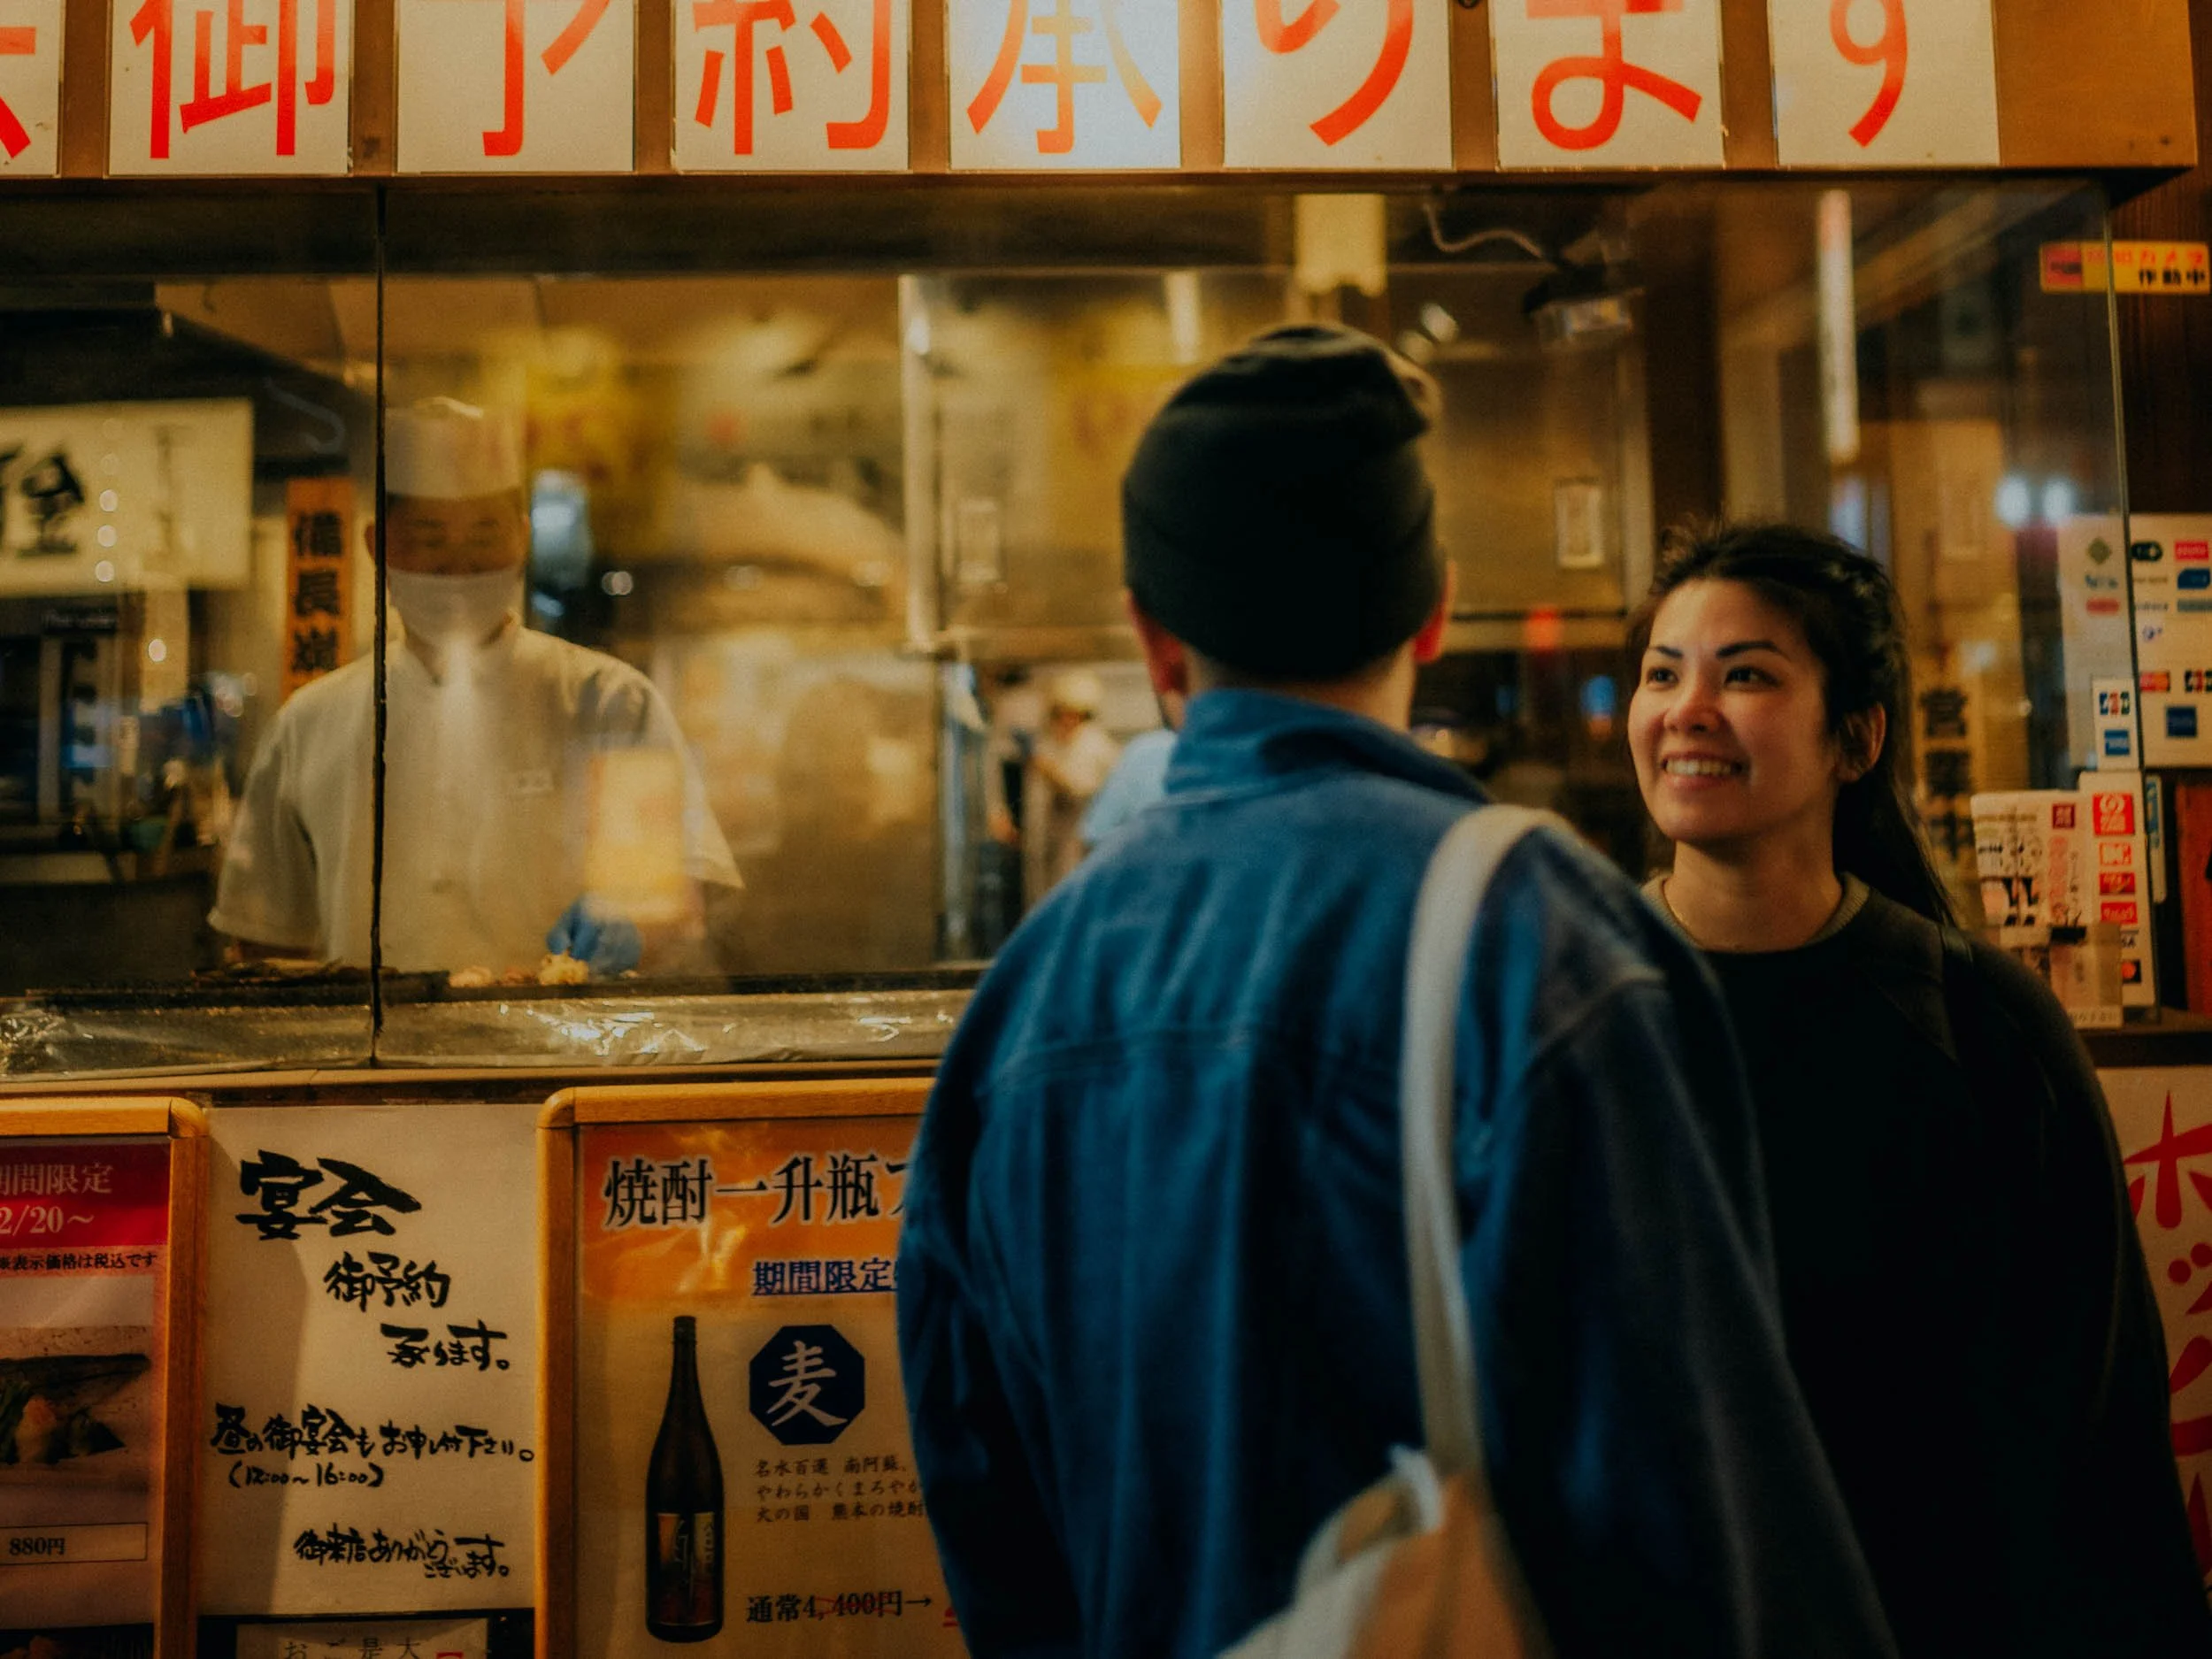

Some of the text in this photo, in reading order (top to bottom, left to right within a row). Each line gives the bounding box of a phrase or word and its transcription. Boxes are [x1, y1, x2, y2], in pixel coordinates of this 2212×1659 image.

[235, 1149, 421, 1240] 宴会
[324, 1251, 450, 1312] 御予約
[752, 1258, 898, 1294] 期間限定
[766, 1340, 849, 1427] 麦
[9, 1536, 66, 1556] 880円
